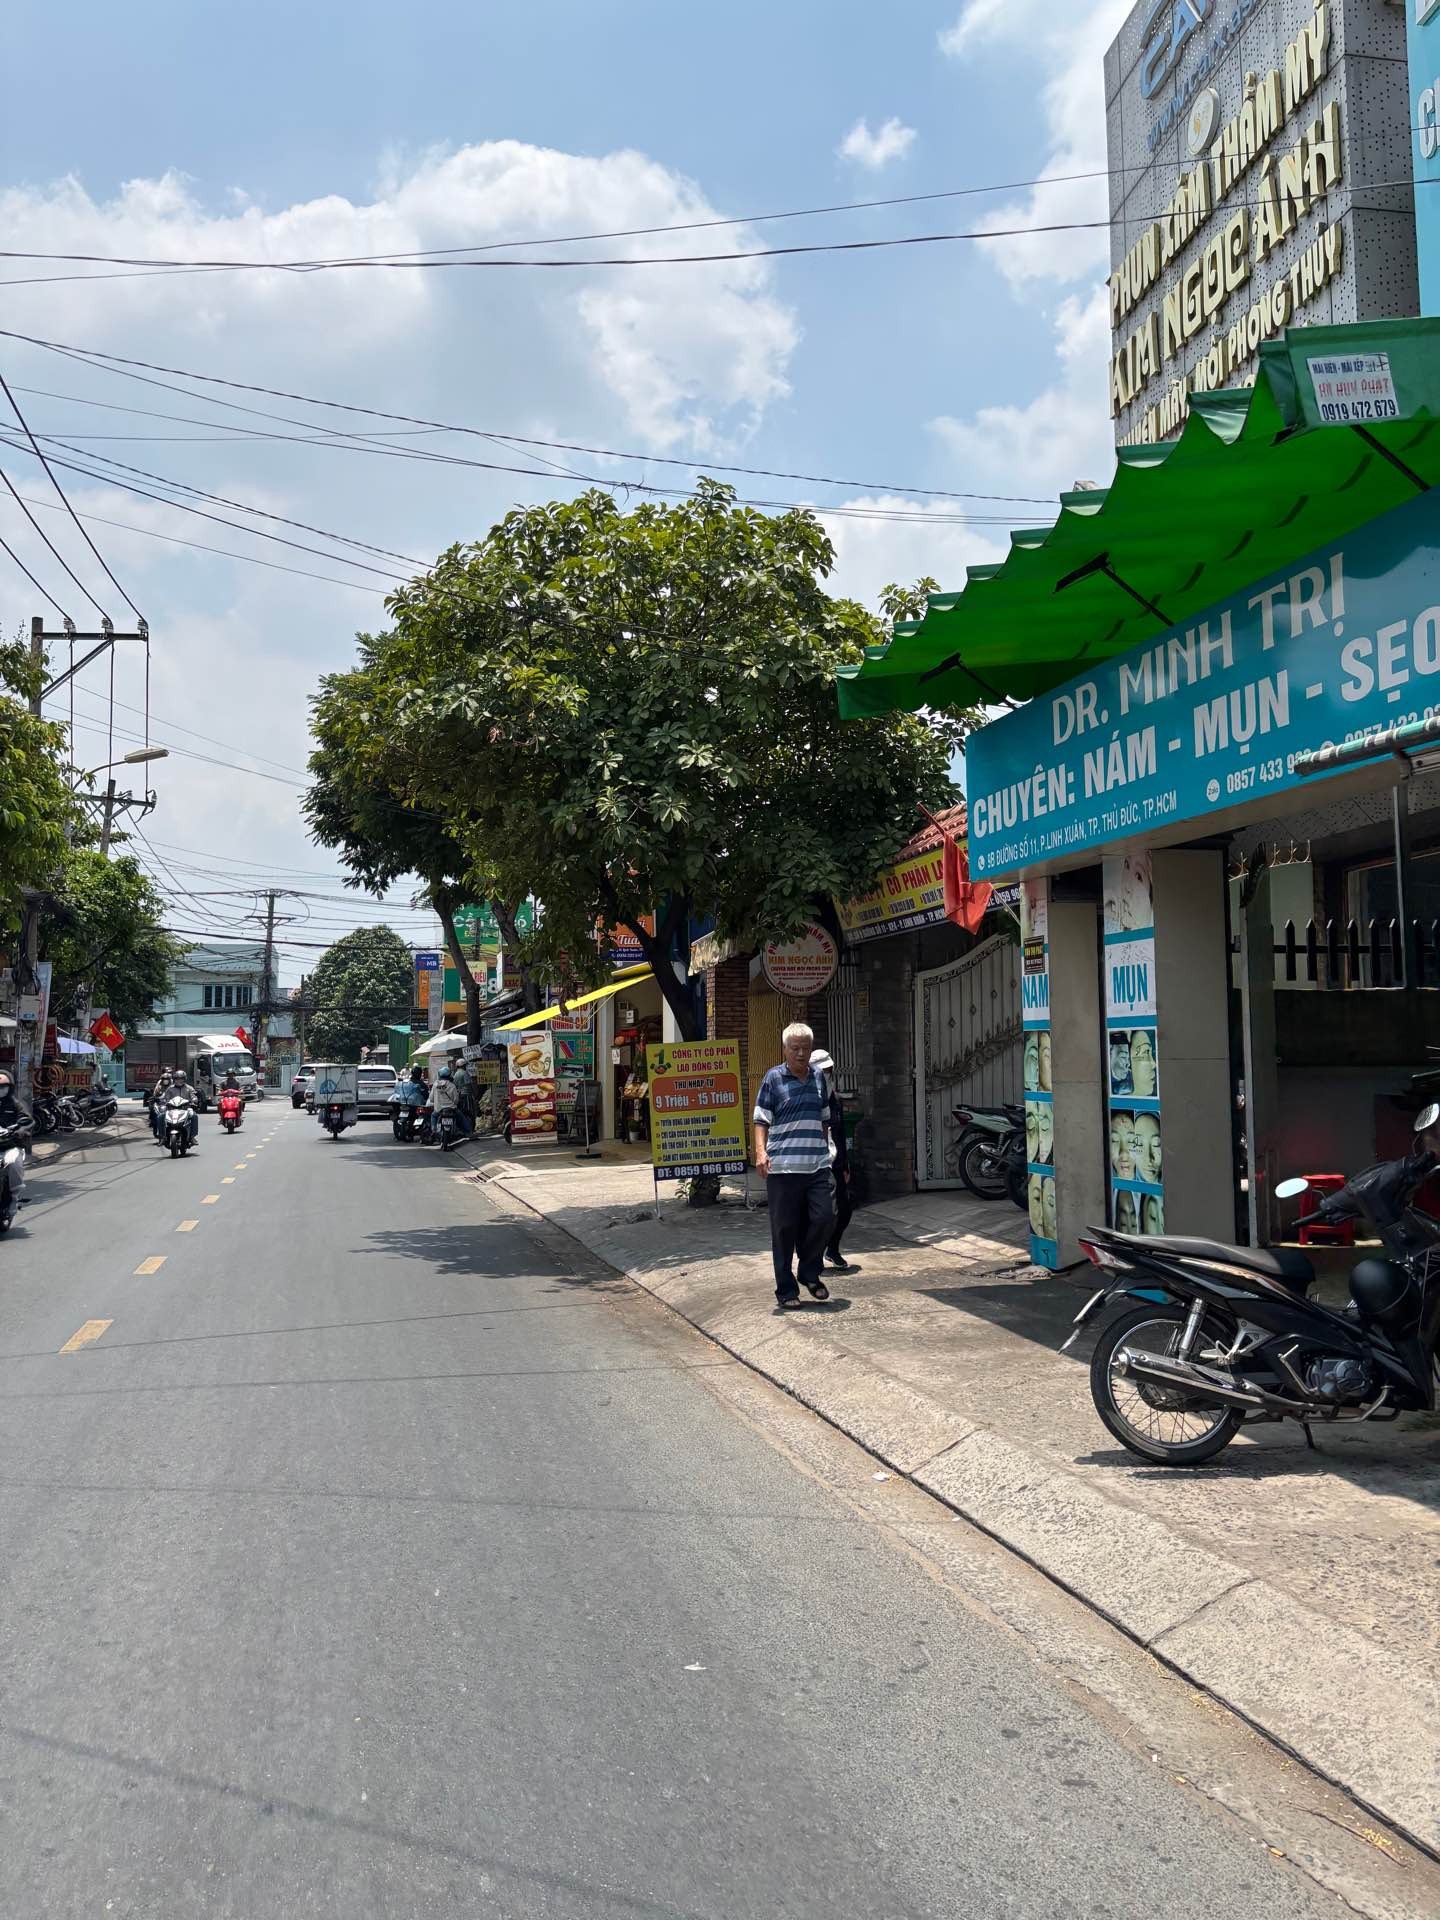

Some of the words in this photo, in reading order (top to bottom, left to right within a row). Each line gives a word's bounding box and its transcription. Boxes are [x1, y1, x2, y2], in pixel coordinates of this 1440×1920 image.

[1109, 311, 1160, 420] KIM
[1163, 208, 1250, 362] NGỌC
[1252, 101, 1342, 263] ÁNH
[1109, 222, 1161, 330] PHUN
[1228, 281, 1286, 373] PHONG
[1321, 403, 1350, 420] 0919
[1351, 400, 1373, 418] 472
[1374, 399, 1396, 417] 679
[1052, 680, 1109, 747] DR.
[1119, 610, 1234, 716] MINH
[1248, 551, 1345, 652] TRỊ
[973, 759, 1076, 839] CHUYÊN:
[1083, 725, 1157, 798] NÁM
[1168, 738, 1182, 753] -
[1193, 668, 1290, 759] MỤN
[1306, 681, 1323, 700] -
[1226, 766, 1256, 794] 0857
[1259, 758, 1284, 783] 433
[996, 840, 1018, 867] ĐƯỜNG
[1019, 832, 1029, 859] SỐ
[1102, 805, 1119, 832] THỦ
[1120, 801, 1142, 825] ĐỨC,
[1143, 790, 1177, 818] TP.HCM
[1112, 963, 1148, 1011] MỤN
[672, 1048, 692, 1059] CÔNG
[694, 1047, 702, 1058] TY
[677, 1063, 690, 1072] LAO
[692, 1061, 712, 1073] ĐỘNG
[714, 1060, 724, 1070] SỐ
[655, 1095, 662, 1109] 9
[665, 1094, 689, 1108] Triệu
[697, 1092, 708, 1105] 15
[711, 1091, 735, 1104] Triệu
[674, 1081, 687, 1090] THU
[674, 1165, 700, 1177] 0859
[702, 1163, 722, 1174] 966
[724, 1161, 744, 1173] 663
